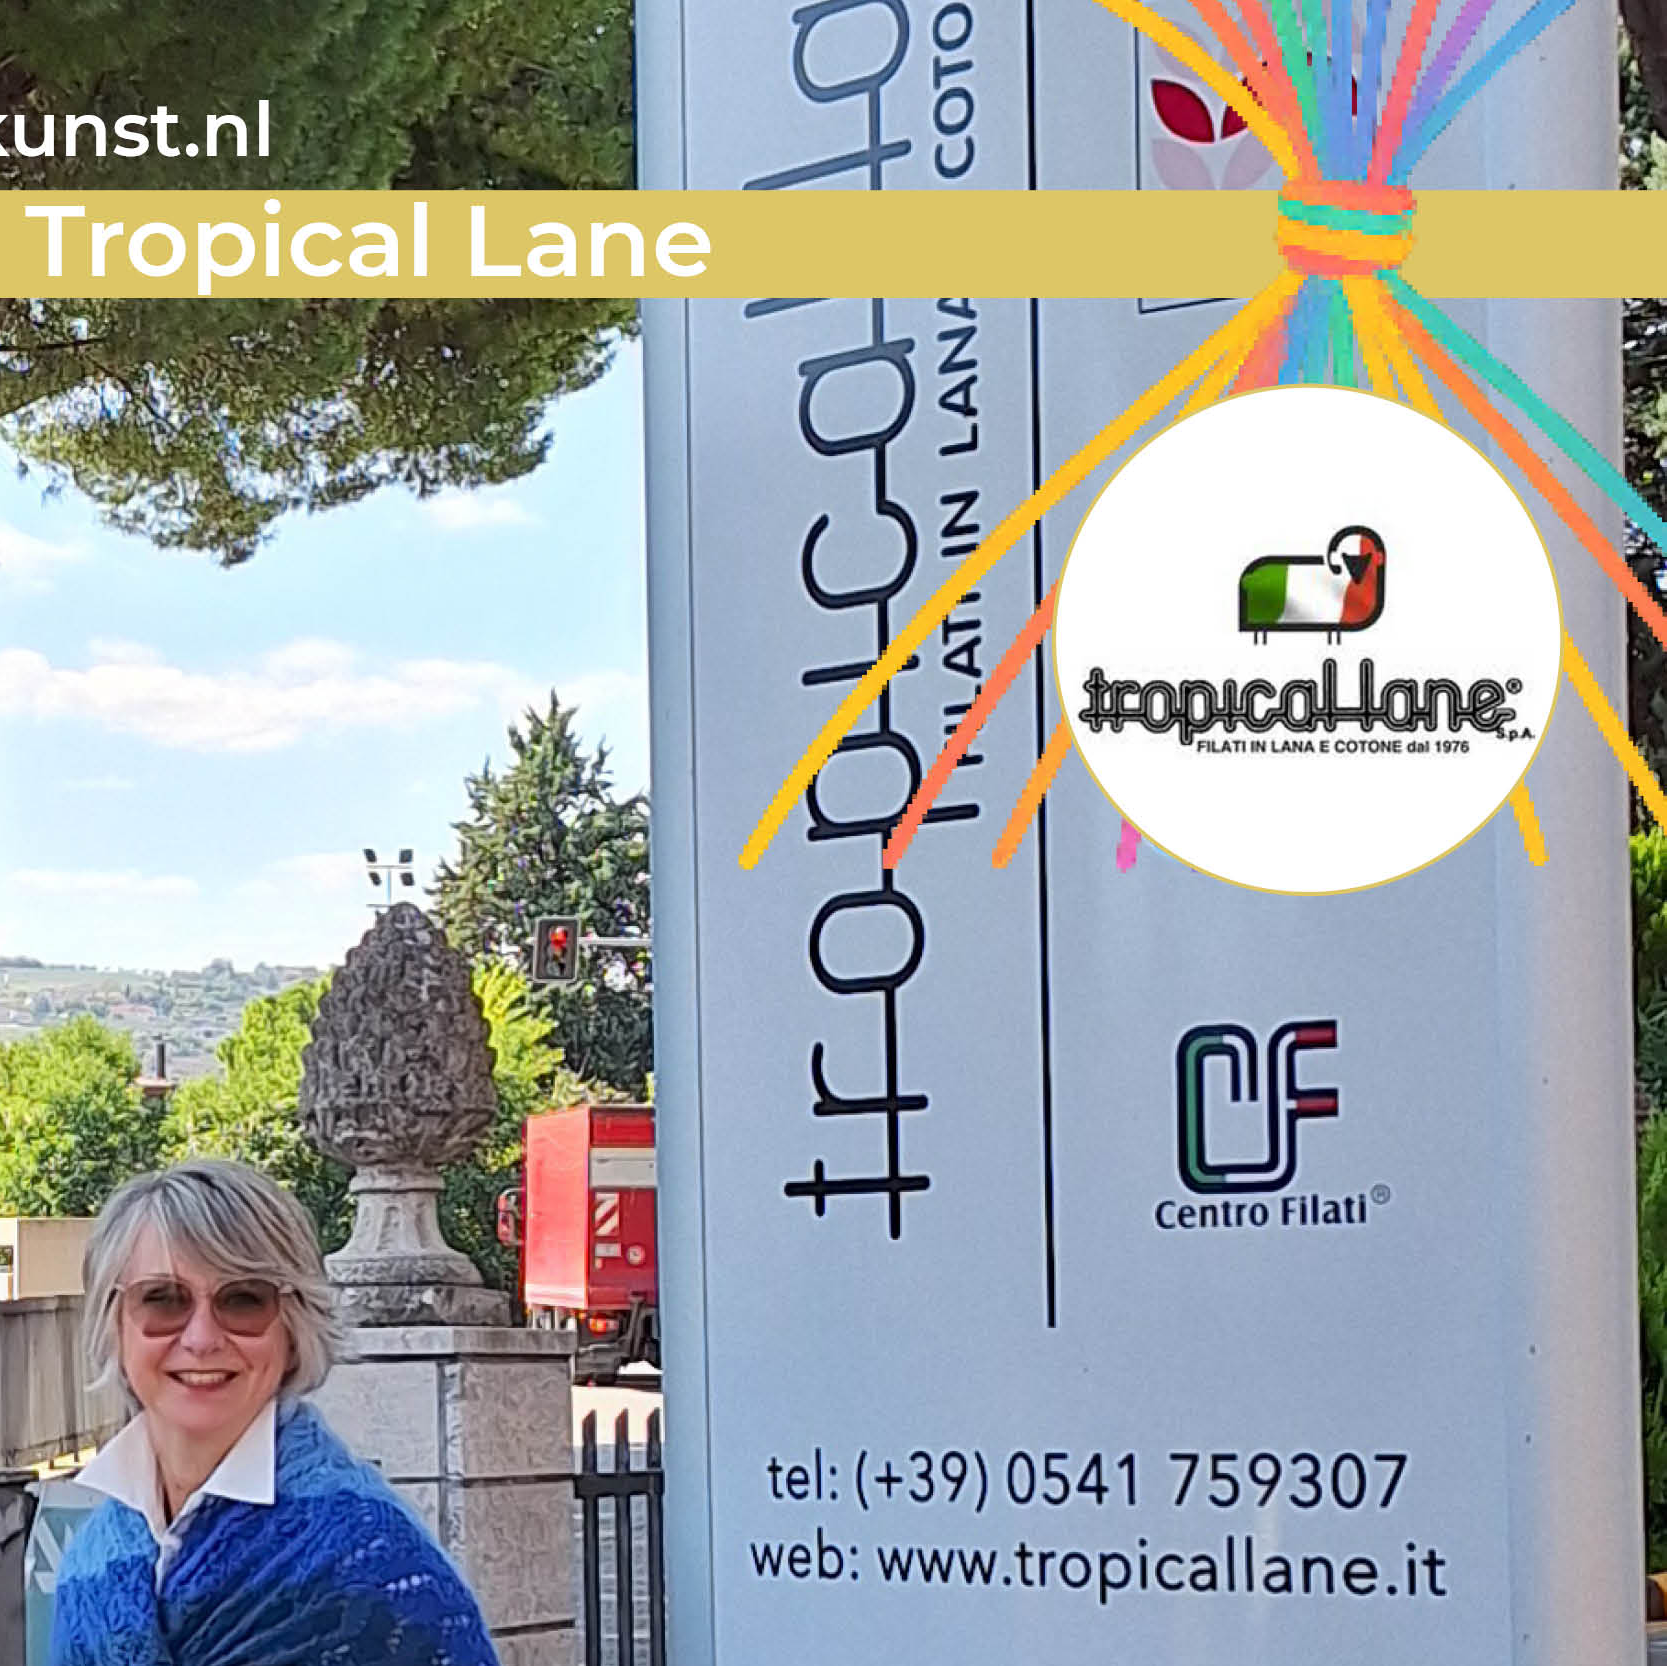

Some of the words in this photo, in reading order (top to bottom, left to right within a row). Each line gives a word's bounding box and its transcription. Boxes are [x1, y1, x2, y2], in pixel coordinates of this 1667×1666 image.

[1154, 1200, 1269, 1230] Centro
[1281, 1193, 1367, 1227] Filati
[767, 1448, 838, 1500] tel:
[855, 1450, 988, 1513] (+39)
[1006, 1450, 1137, 1507] 0541
[1169, 1452, 1408, 1509] 759307
[749, 1527, 860, 1582] web:
[876, 1535, 1447, 1605] www.tropicallane.it
